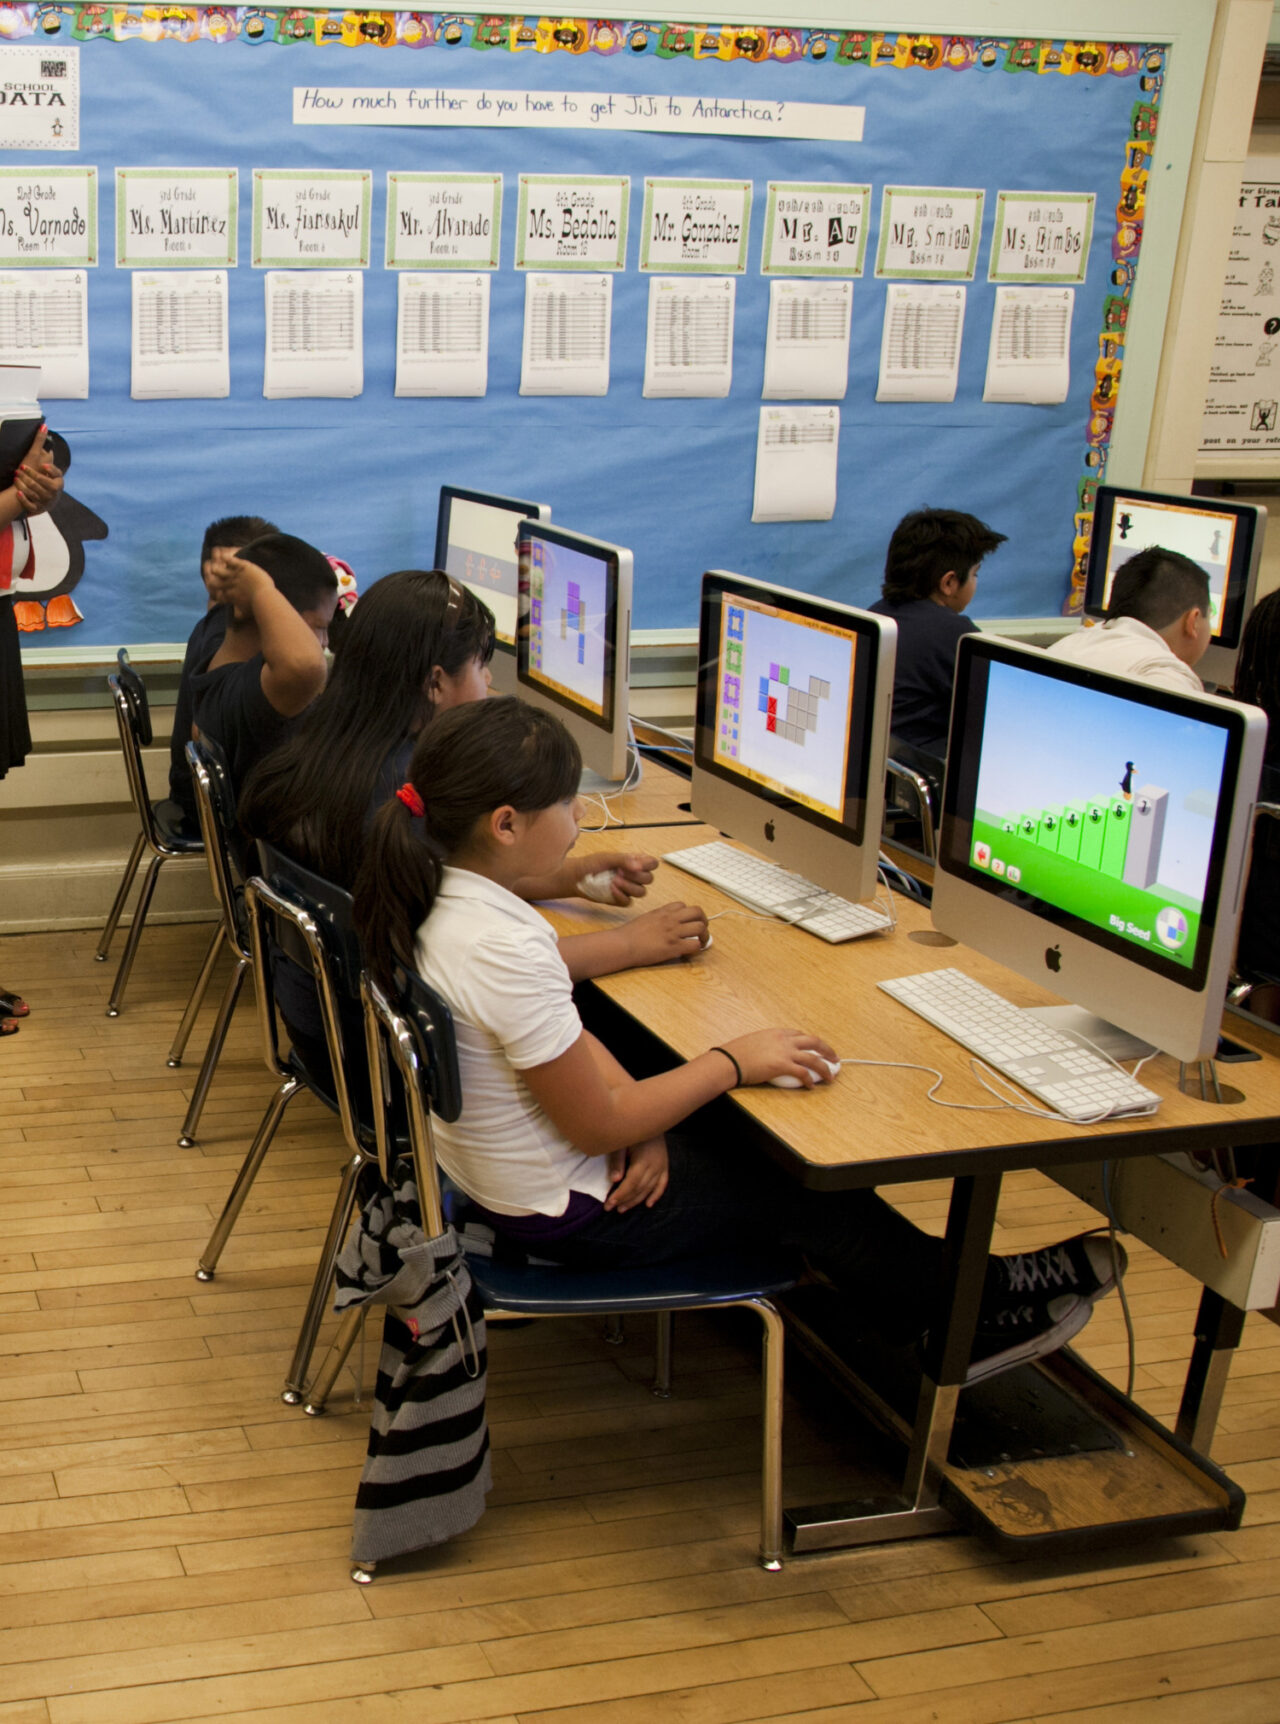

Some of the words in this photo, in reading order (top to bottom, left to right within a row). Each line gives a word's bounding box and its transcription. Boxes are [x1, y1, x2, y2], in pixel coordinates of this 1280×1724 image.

[4, 82, 57, 92] SCHOOL
[302, 89, 344, 109] How
[352, 91, 397, 110] much
[408, 89, 468, 111] further
[476, 92, 492, 111] do
[495, 97, 519, 117] you
[525, 94, 555, 112] have
[562, 94, 578, 113] to
[590, 95, 616, 122] get
[625, 95, 658, 116] JiJi
[666, 97, 682, 116] to
[17, 186, 32, 201] 2nd
[33, 185, 57, 200] Grade
[23, 201, 87, 236] Varnado
[129, 205, 155, 235] Ms.
[159, 205, 227, 237] Martínez
[266, 204, 290, 230] Ms.
[400, 207, 423, 236] Mr.
[427, 208, 490, 240] Alvarado
[529, 208, 556, 240] Ms.
[561, 208, 617, 240] Bedolla
[653, 212, 676, 242] Mr.
[681, 211, 740, 244] González
[18, 237, 41, 252] Room
[780, 218, 818, 242] Mr.
[828, 217, 857, 247] Au
[891, 223, 919, 248] Mr.
[924, 223, 970, 249] Smith
[1004, 227, 1031, 252] Ms.
[1092, 809, 1099, 822] 5
[1116, 804, 1122, 818] 6
[1140, 800, 1148, 813] 7
[1026, 821, 1033, 833] 2
[1047, 817, 1054, 829] 3
[1069, 813, 1076, 826] 4
[1109, 913, 1126, 933] Big
[1126, 921, 1152, 942] Seed
